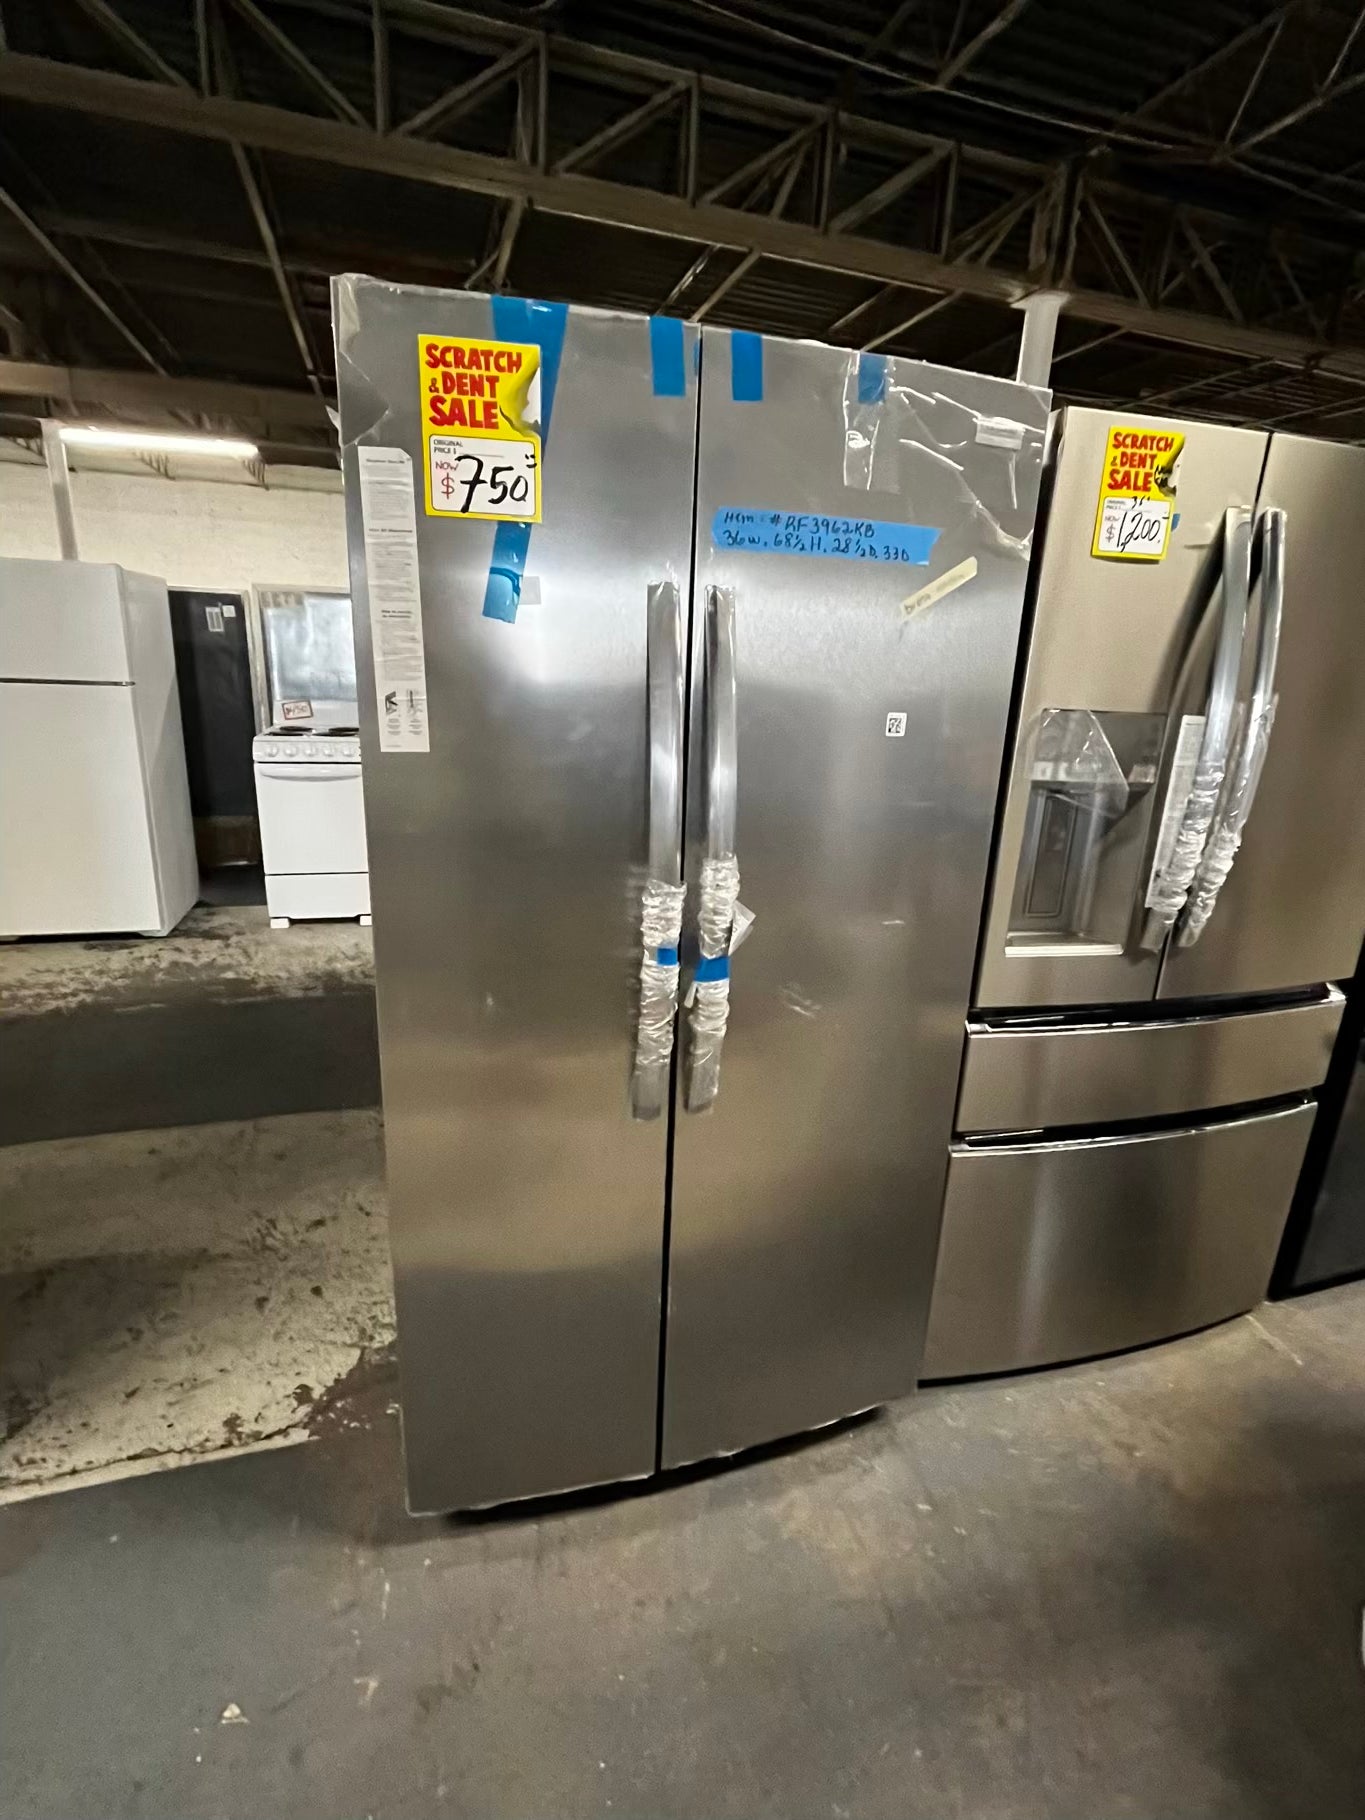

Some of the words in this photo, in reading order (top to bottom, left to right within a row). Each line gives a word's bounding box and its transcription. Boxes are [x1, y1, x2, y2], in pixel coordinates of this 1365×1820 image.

[425, 343, 522, 374] SCRATCH
[429, 377, 440, 394] &
[441, 371, 500, 399] DENT
[429, 395, 500, 430] SALE
[433, 439, 463, 448] ORIGINAL
[1112, 432, 1175, 452] SCRATCH
[435, 460, 459, 471] NOW
[1120, 452, 1158, 470] DENT
[454, 454, 529, 514] 750
[1107, 469, 1154, 492] SALE
